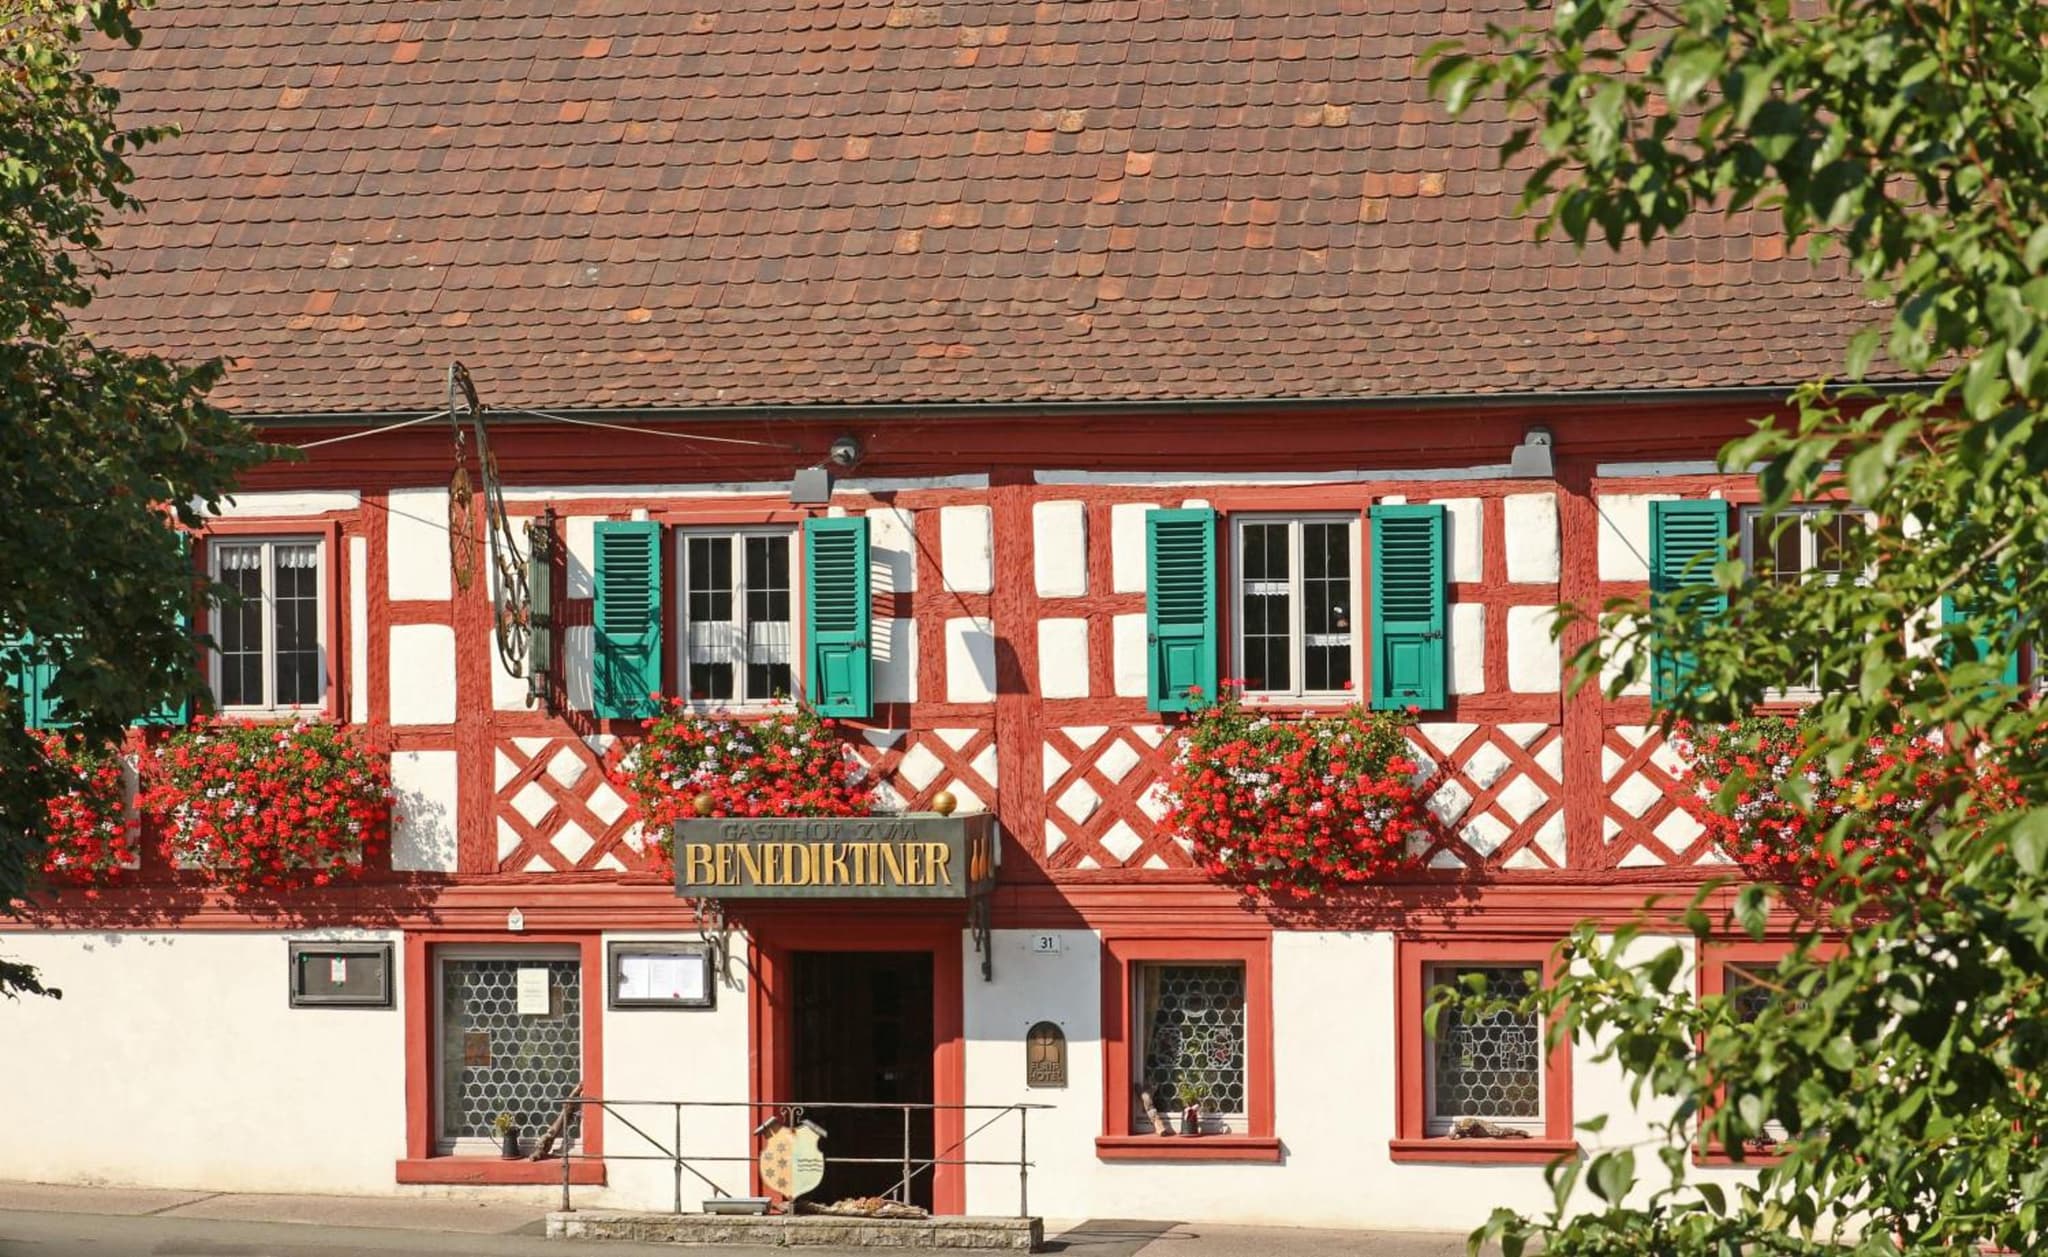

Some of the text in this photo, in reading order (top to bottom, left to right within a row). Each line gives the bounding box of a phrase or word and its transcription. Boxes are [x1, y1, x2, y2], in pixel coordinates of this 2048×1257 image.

[720, 822, 842, 841] GASTHOF
[686, 842, 951, 887] BENEDIKTINER
[1040, 936, 1053, 949] 31
